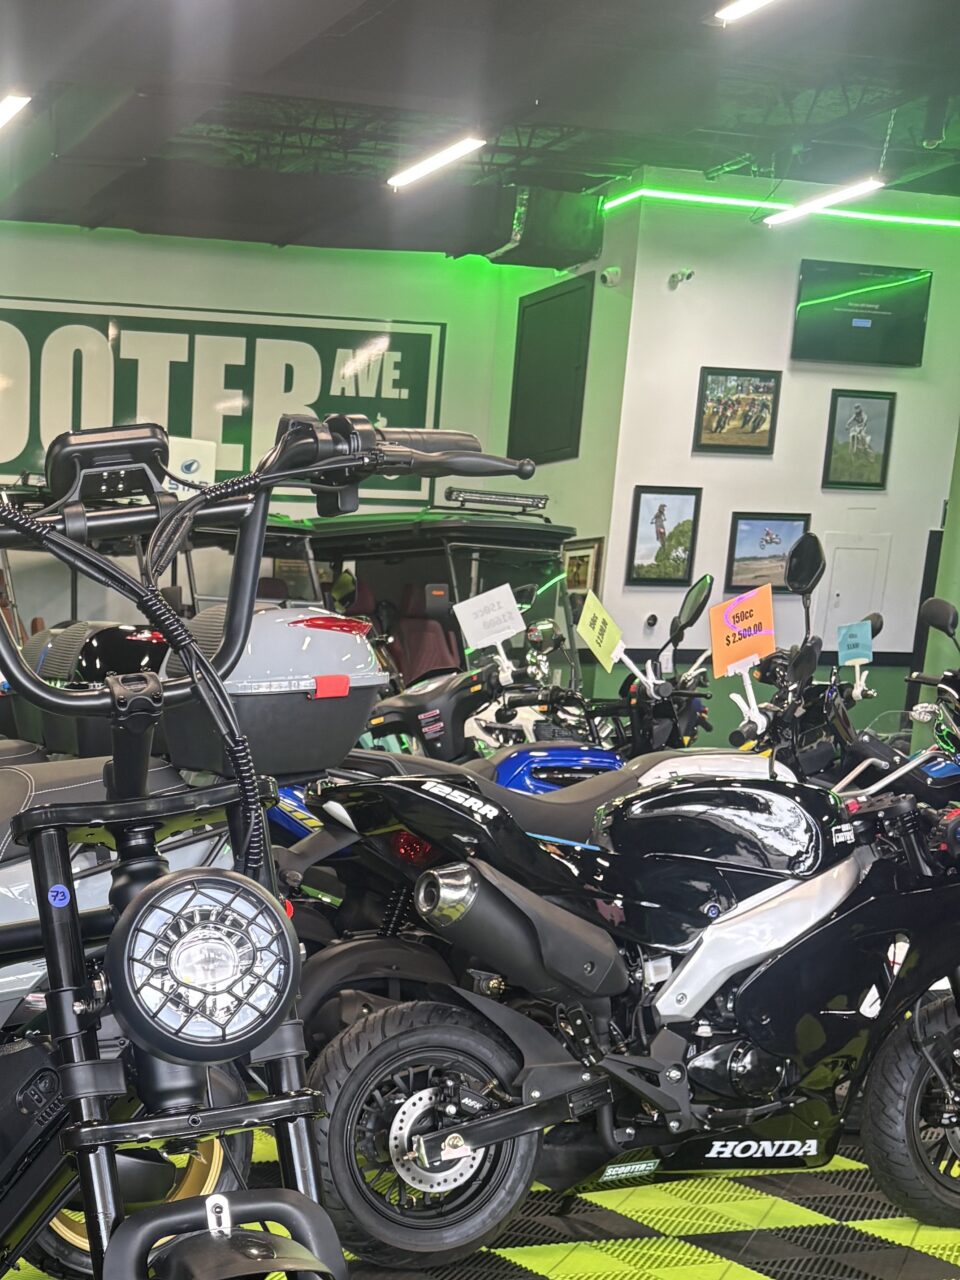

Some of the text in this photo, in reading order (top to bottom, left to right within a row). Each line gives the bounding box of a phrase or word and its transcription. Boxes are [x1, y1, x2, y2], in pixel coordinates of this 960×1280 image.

[732, 608, 754, 625] 150cc
[421, 781, 499, 820] 125RR
[50, 890, 67, 901] 73
[704, 1139, 818, 1158] HONDA
